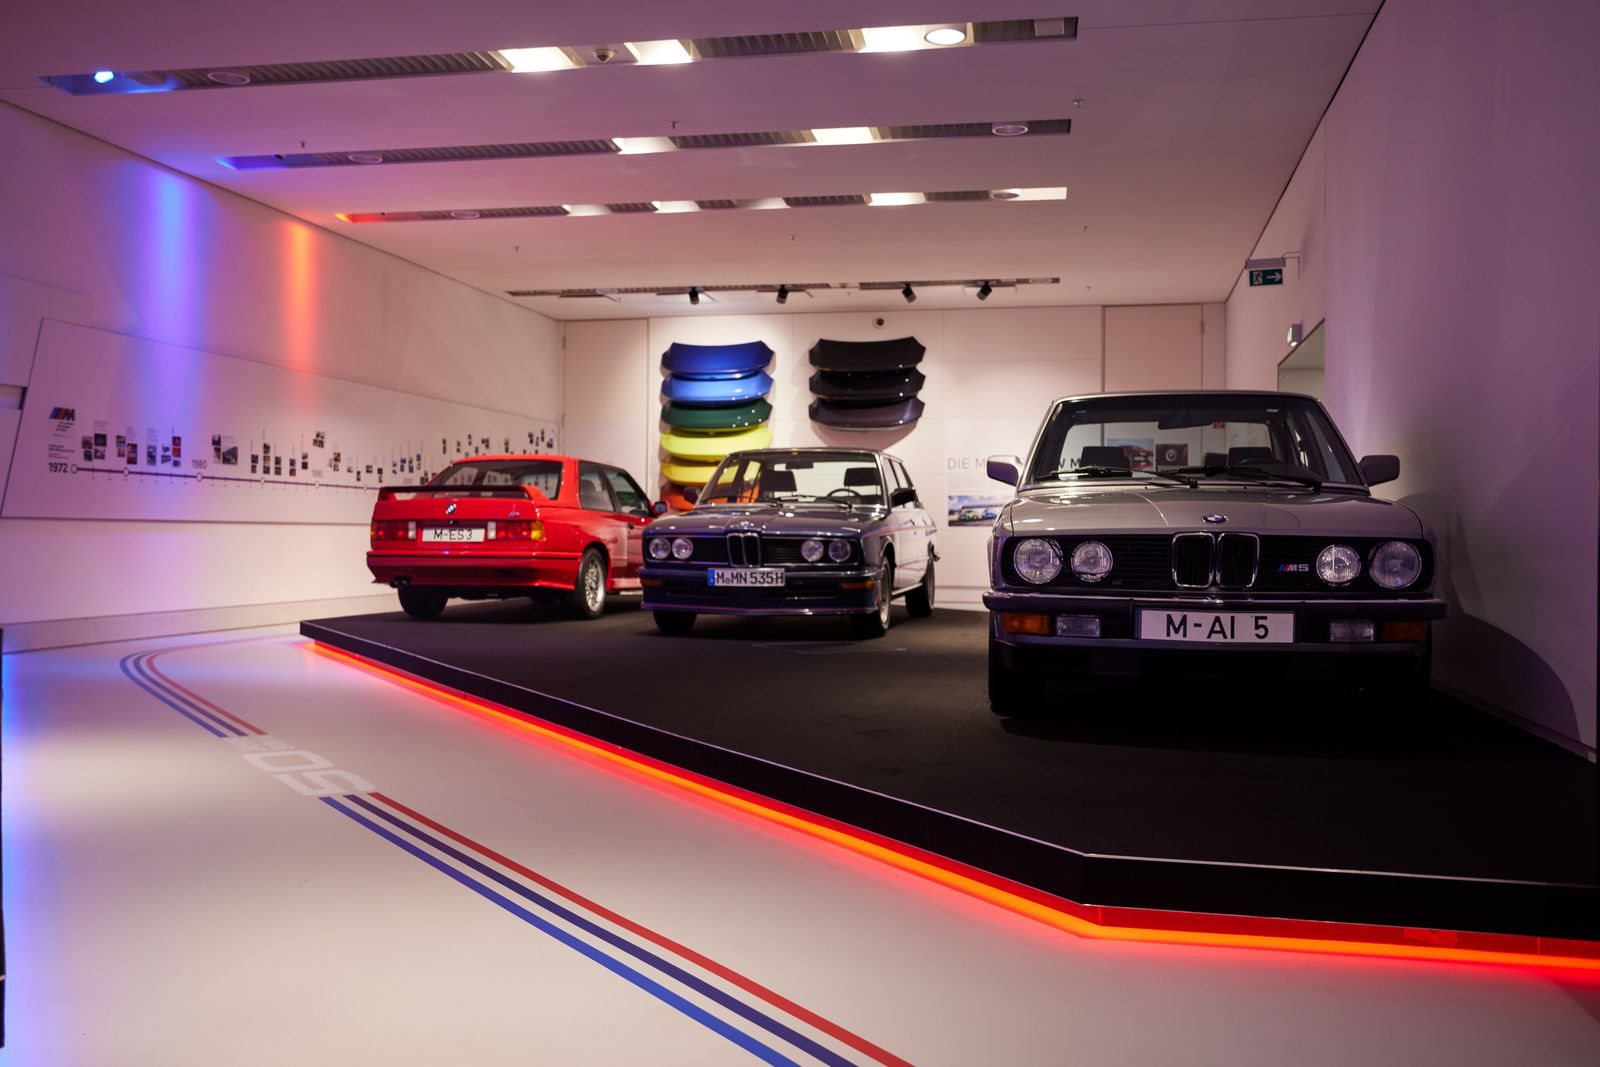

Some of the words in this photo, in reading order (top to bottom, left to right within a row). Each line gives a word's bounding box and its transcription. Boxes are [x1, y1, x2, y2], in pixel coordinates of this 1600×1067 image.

[48, 462, 69, 473] 1972
[947, 457, 970, 470] DIE
[1284, 564, 1309, 572] M5
[750, 572, 784, 584] 535H
[1254, 616, 1269, 639] 5
